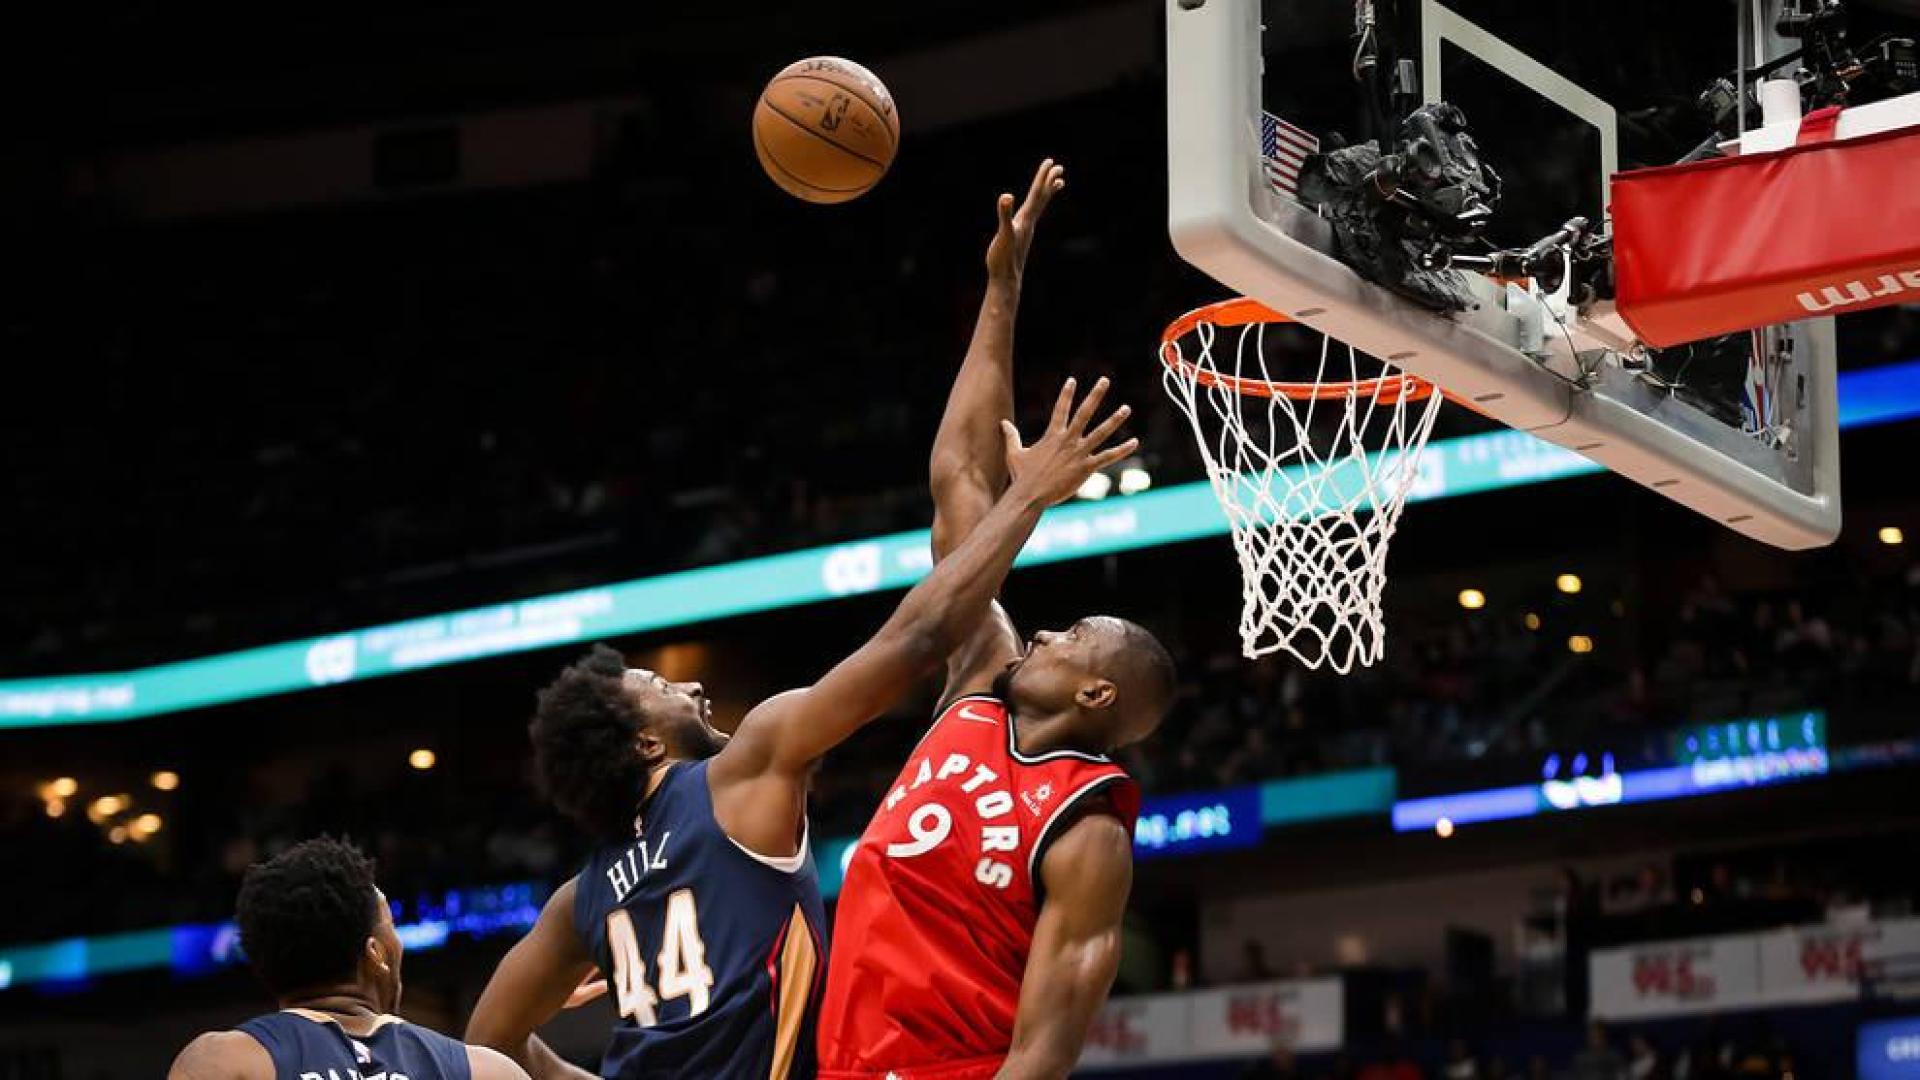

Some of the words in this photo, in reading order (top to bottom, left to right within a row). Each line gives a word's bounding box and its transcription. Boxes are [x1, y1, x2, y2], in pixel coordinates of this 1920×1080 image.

[886, 802, 953, 857] 9
[606, 831, 671, 902] HILL
[606, 888, 714, 1028] 44
